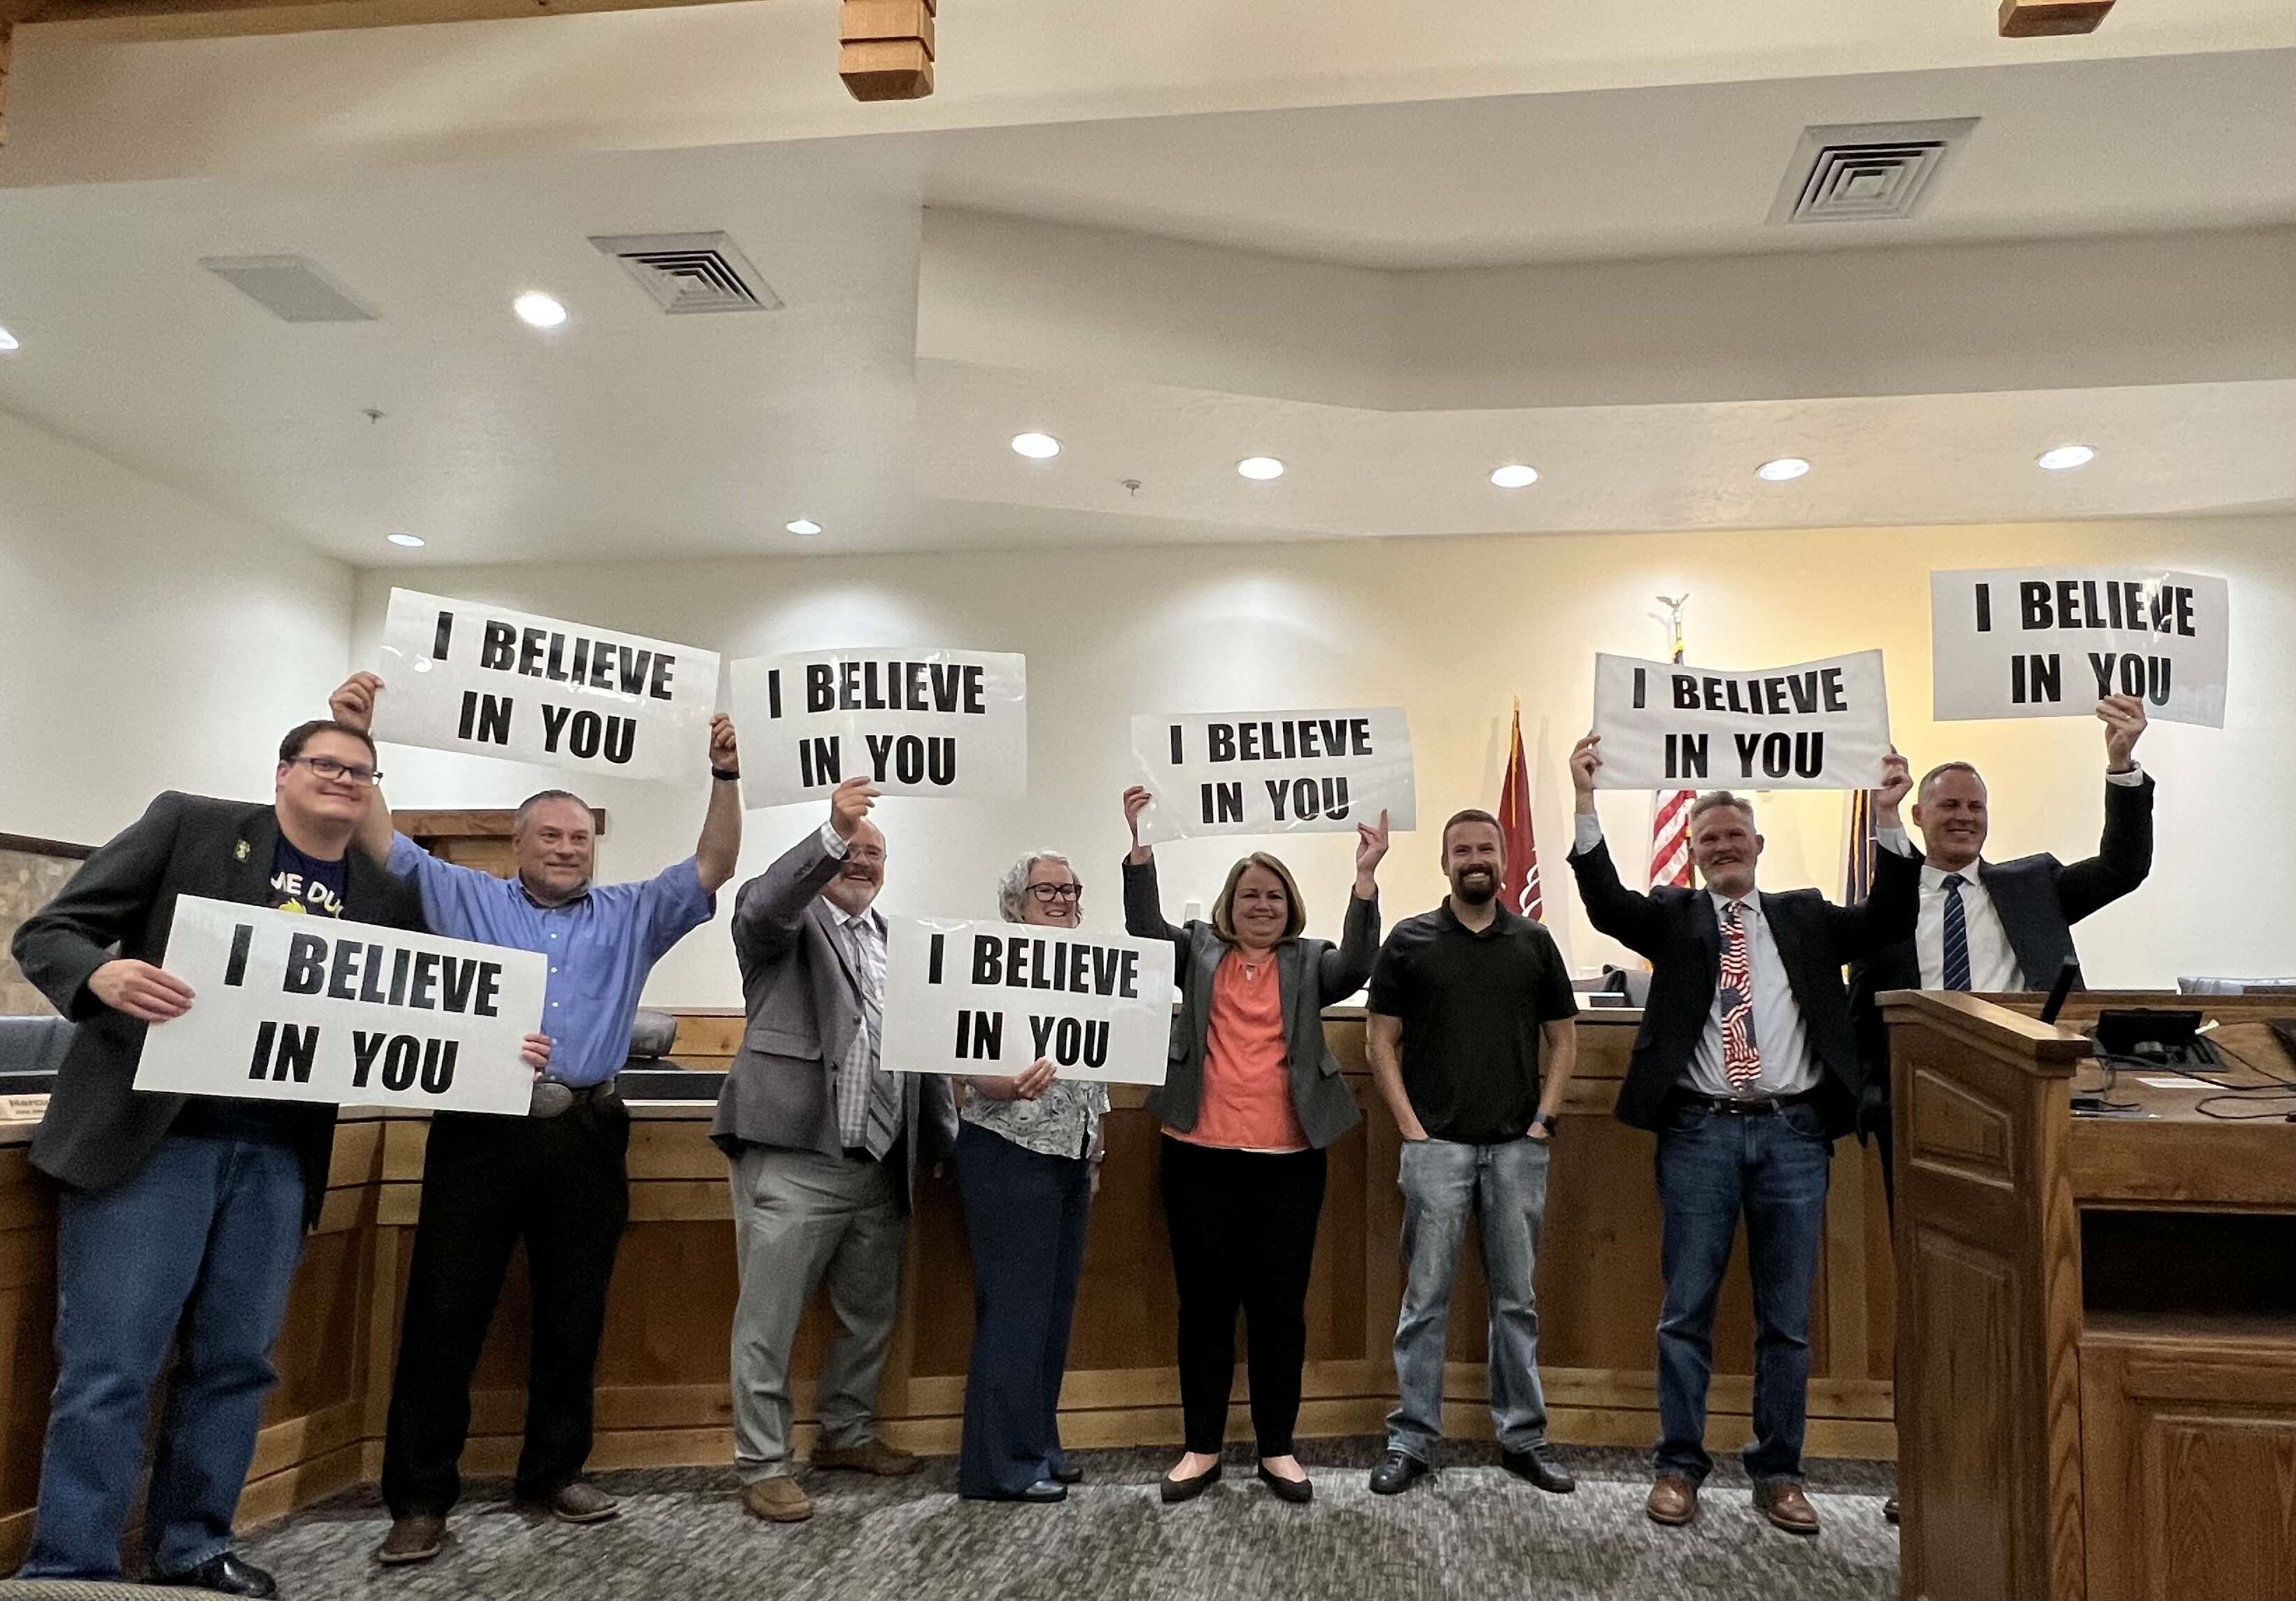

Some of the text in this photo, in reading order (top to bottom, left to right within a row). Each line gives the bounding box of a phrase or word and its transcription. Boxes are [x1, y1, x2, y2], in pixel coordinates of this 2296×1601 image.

[1976, 581, 2195, 636] I BELIEVE
[433, 611, 675, 700] I BELIEVE
[2012, 653, 2170, 706] IN YOU
[769, 662, 985, 718] I BELIEVE
[1634, 668, 1847, 714] I BELIEVE
[458, 691, 636, 763] IN YOU
[1171, 719, 1372, 764] I BELIEVE
[800, 735, 955, 787] IN YOU
[1666, 732, 1823, 778] IN YOU
[1202, 777, 1349, 823] IN YOU
[225, 924, 503, 1017] I BELIEVE
[929, 934, 1140, 998] I BELIEVE
[249, 1022, 458, 1093] IN YOU
[956, 1011, 1109, 1068] IN YOU
